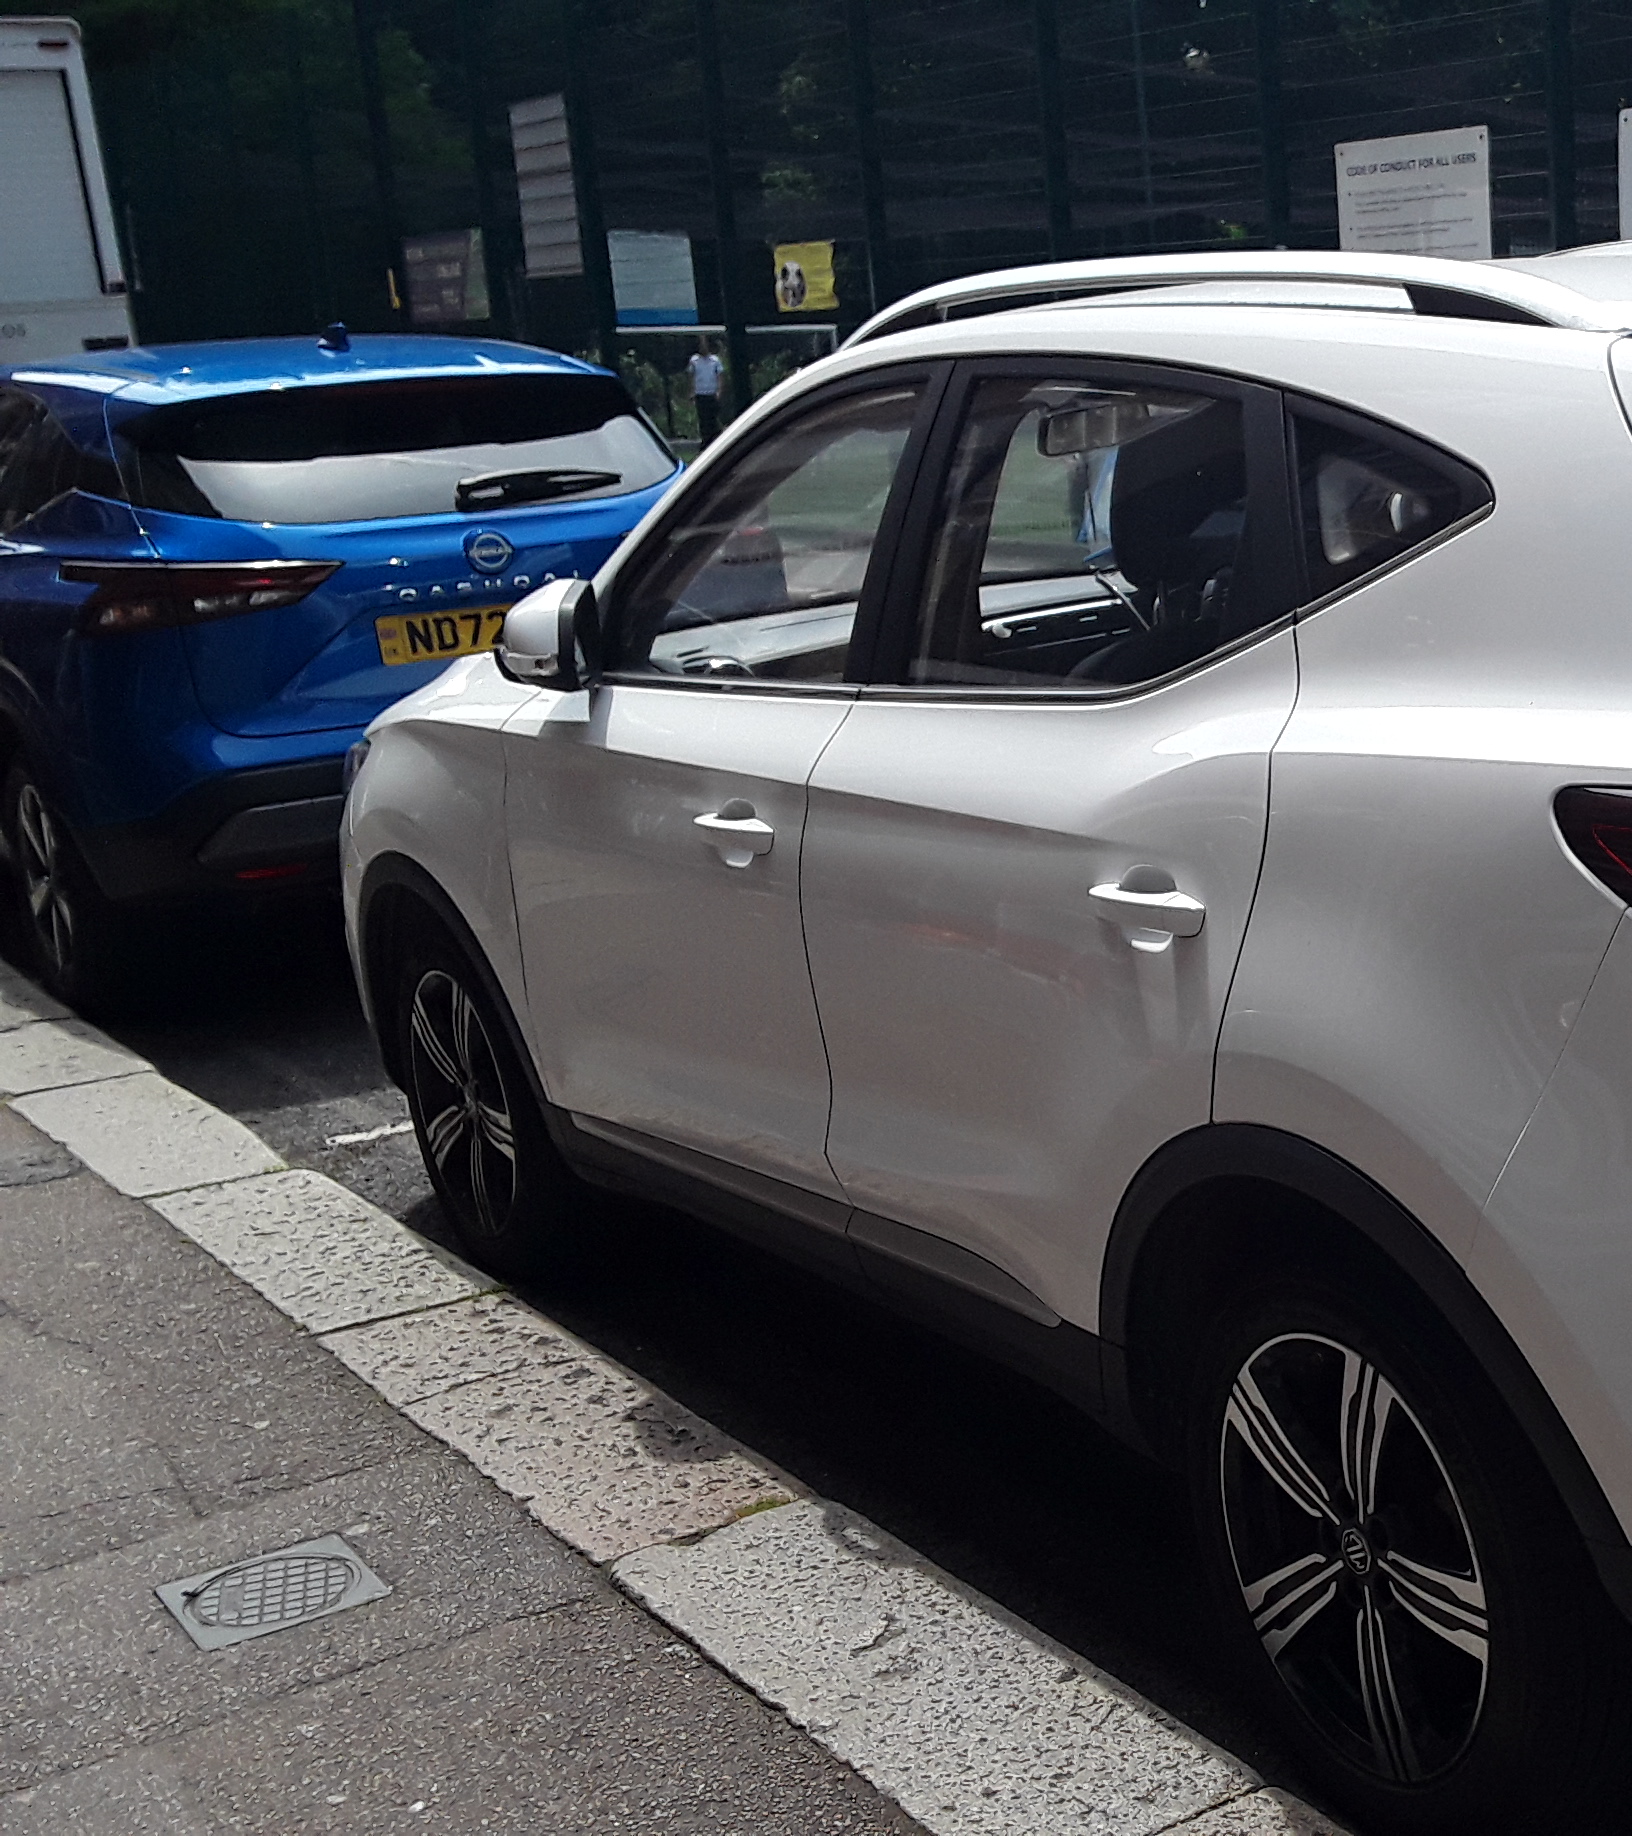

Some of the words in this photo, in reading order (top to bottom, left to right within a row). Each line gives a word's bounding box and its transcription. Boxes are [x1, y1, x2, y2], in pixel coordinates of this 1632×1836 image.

[1346, 165, 1366, 176] CODE
[1380, 160, 1416, 173] CONDUCT
[1451, 152, 1476, 165] USERS
[405, 609, 508, 655] ND72
